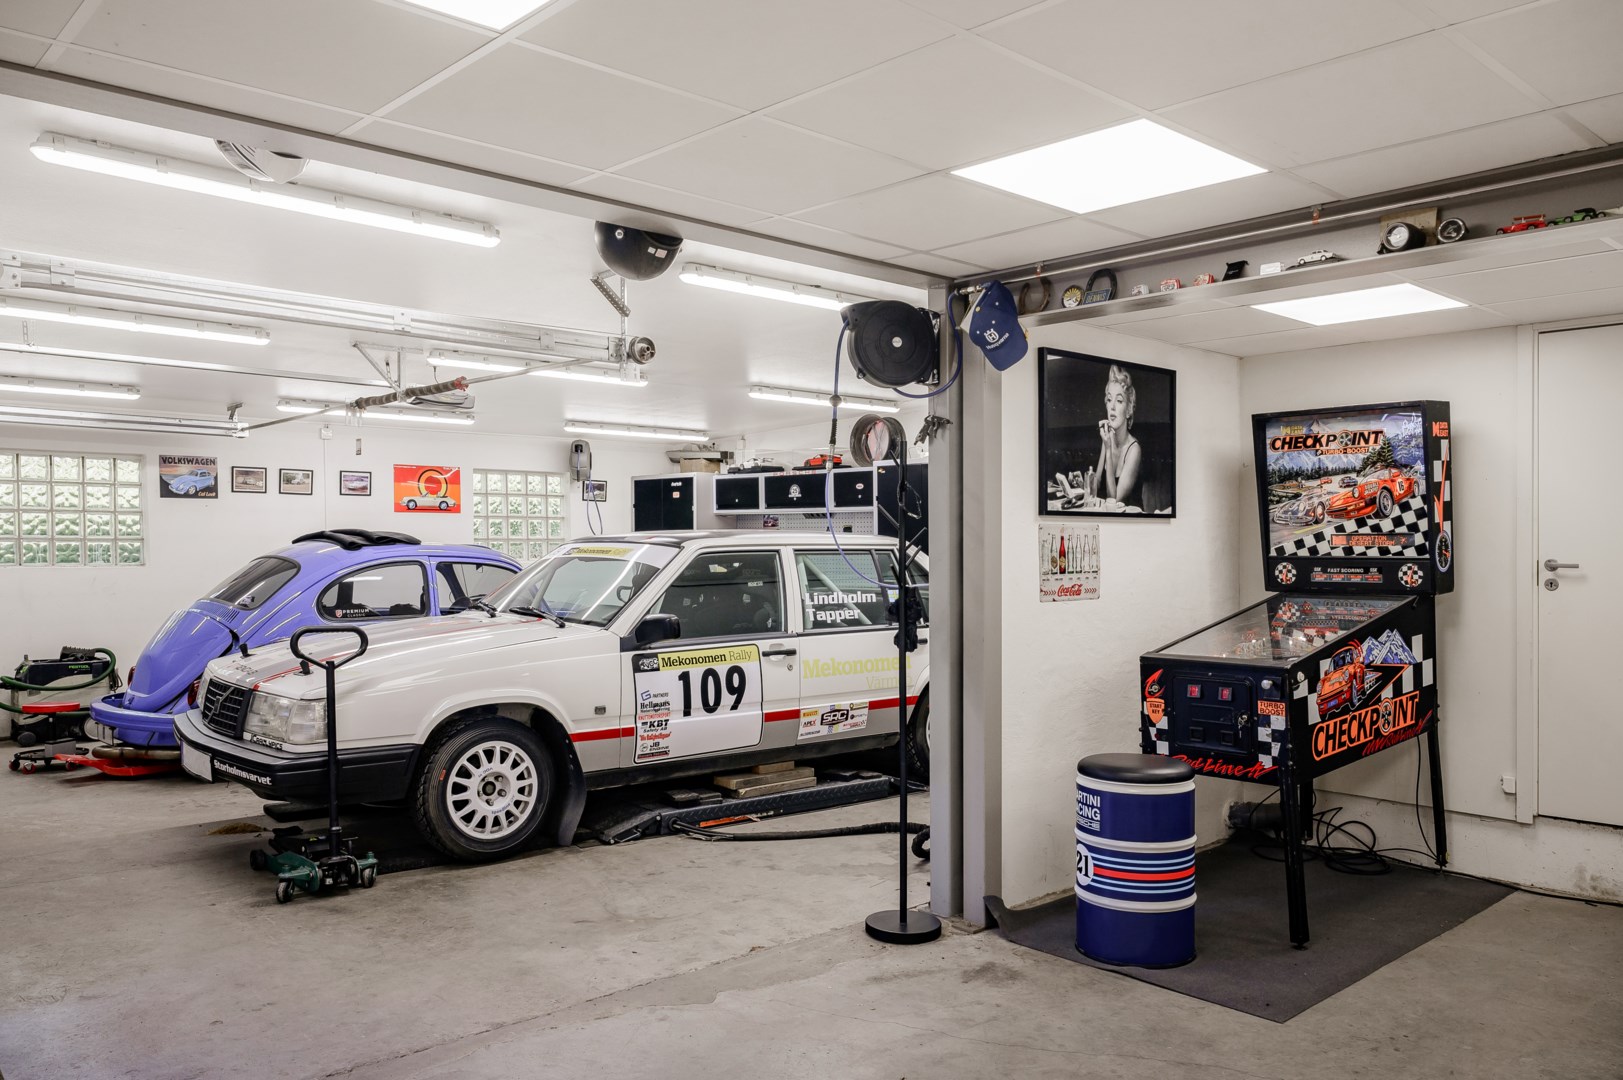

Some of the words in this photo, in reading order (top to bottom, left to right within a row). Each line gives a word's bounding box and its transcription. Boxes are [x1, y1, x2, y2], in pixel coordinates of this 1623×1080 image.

[161, 456, 216, 466] VOLKSWAGEN
[805, 591, 877, 605] Lindholm
[806, 608, 860, 624] Tapper
[661, 653, 727, 668] Mekonomen
[728, 650, 753, 661] Rally
[678, 665, 747, 717] 109
[1260, 701, 1285, 710] TURBO
[649, 719, 670, 728] KBT
[213, 759, 273, 786] Storholmsvarvet
[1077, 789, 1101, 808] RTINI
[1077, 802, 1101, 821] CING
[1077, 850, 1092, 879] 21
